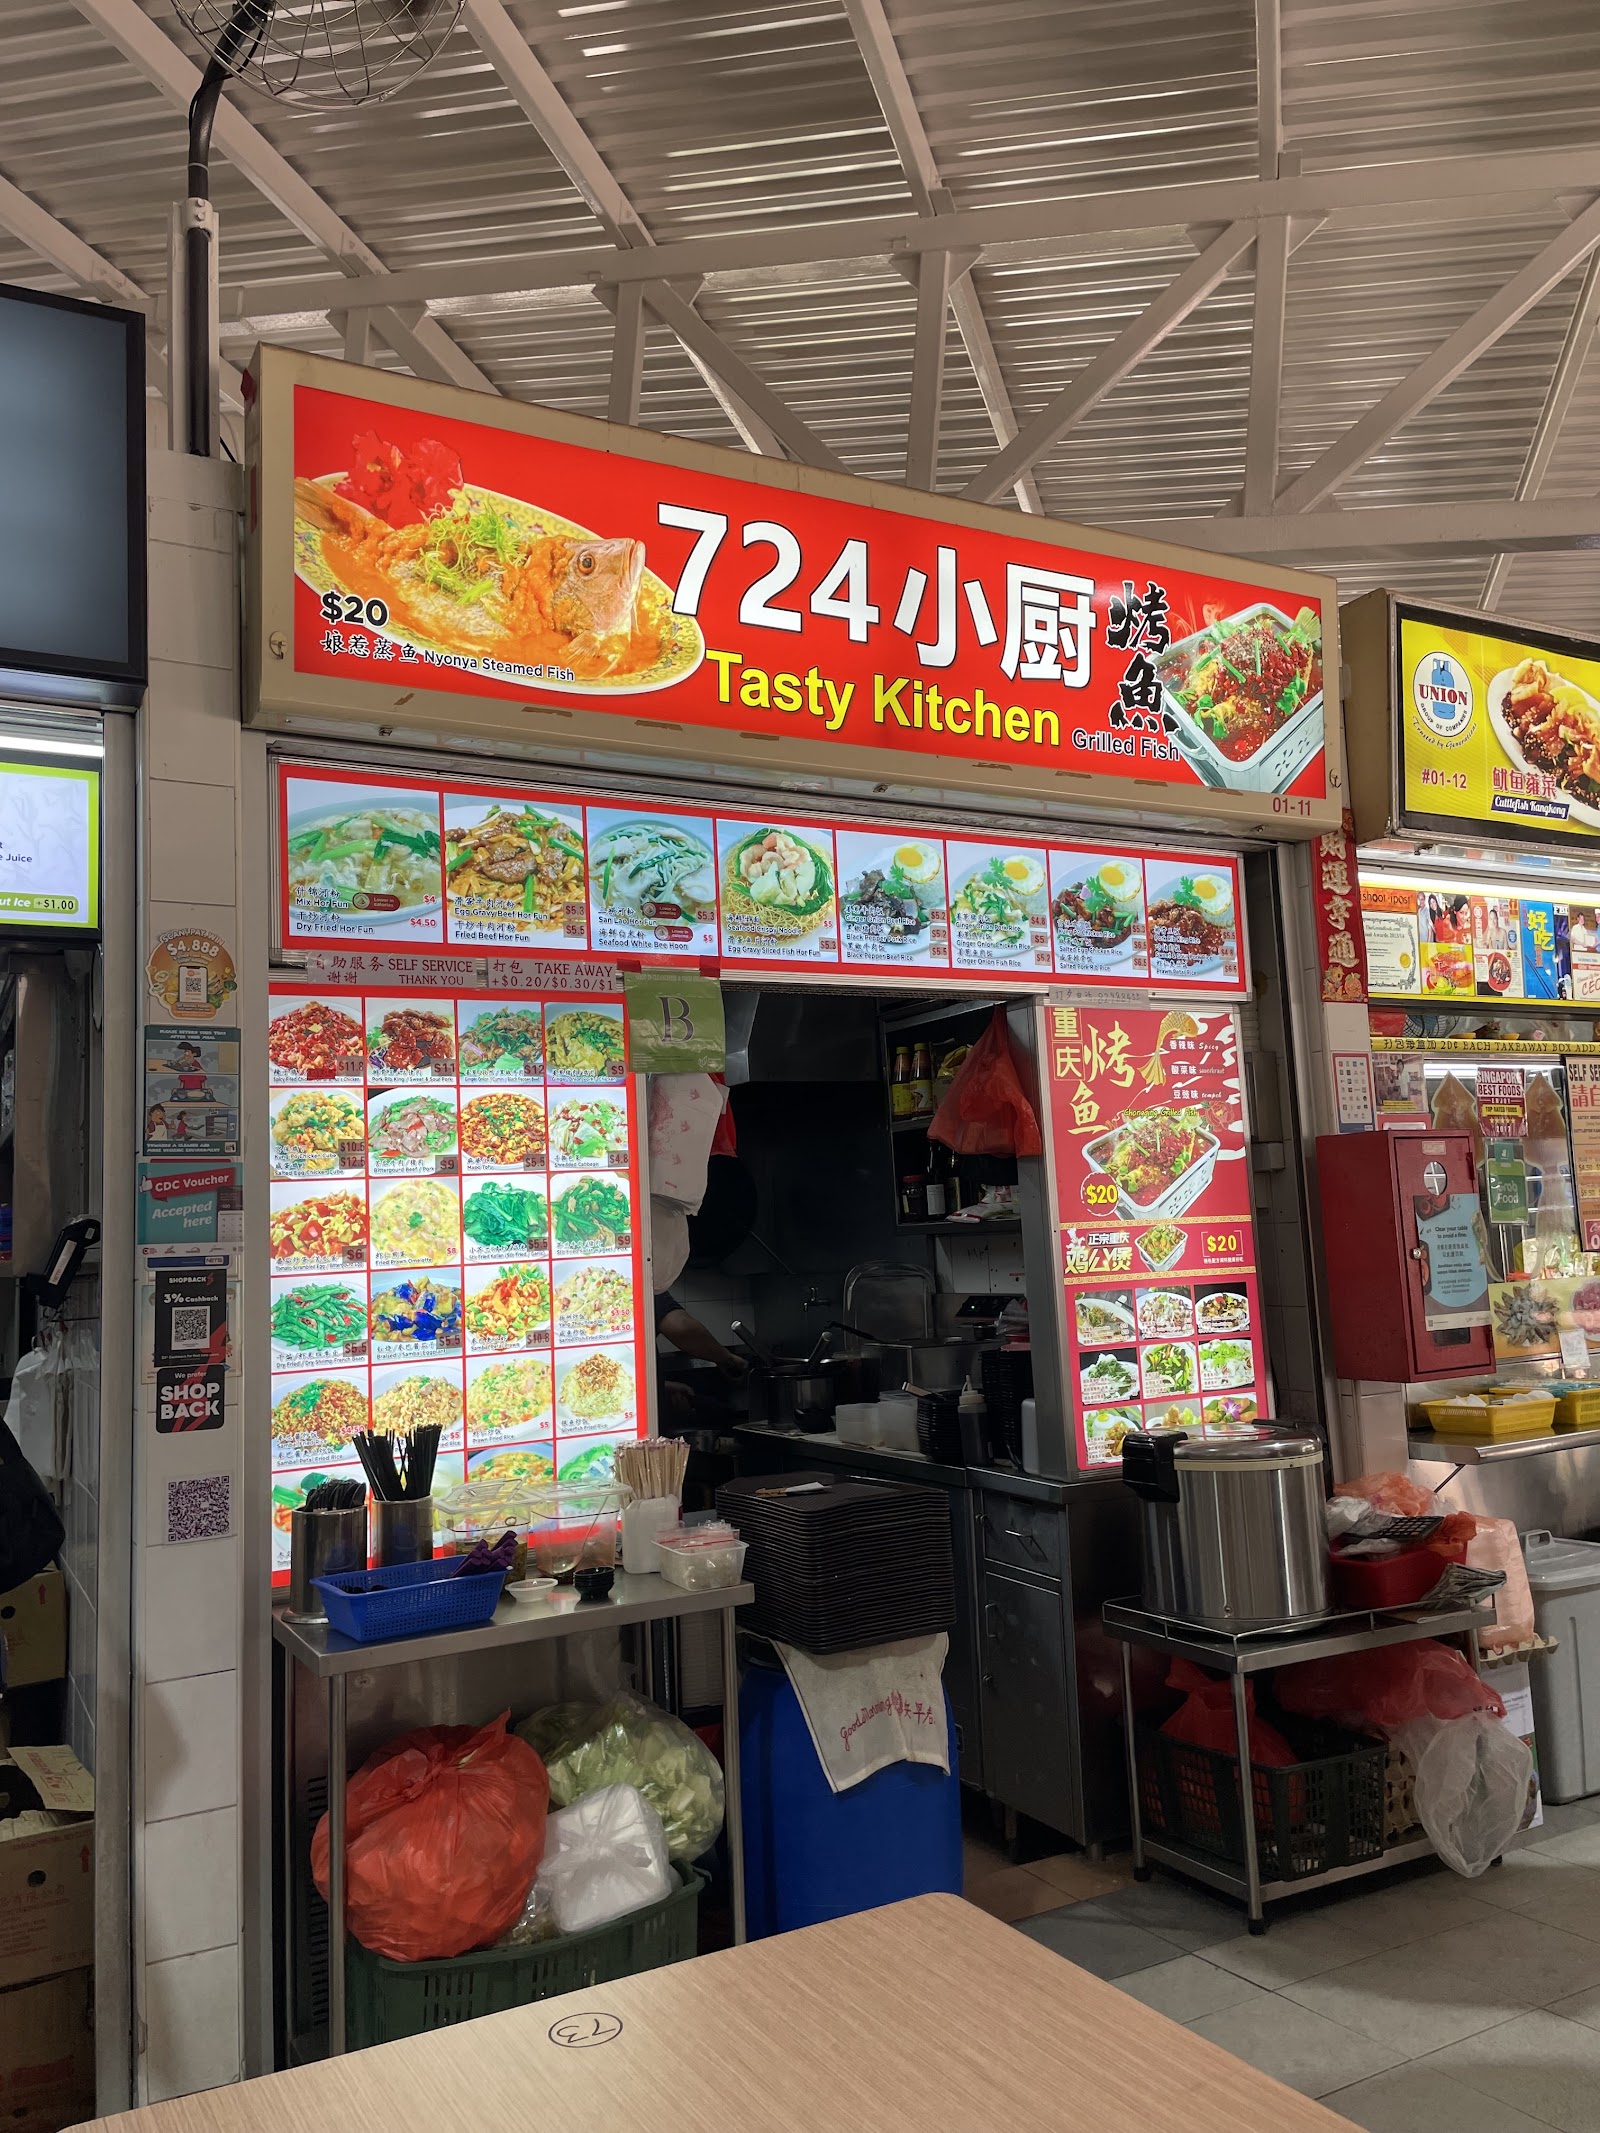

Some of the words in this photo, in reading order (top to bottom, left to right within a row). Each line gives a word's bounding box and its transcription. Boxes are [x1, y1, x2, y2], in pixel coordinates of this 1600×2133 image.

[320, 592, 389, 627] $20
[320, 631, 419, 664] 娘惹蒸鱼
[424, 650, 478, 672] Nyonya
[482, 657, 543, 681] Steamed
[546, 665, 575, 683] Fish
[706, 650, 856, 731] Tasty
[873, 673, 1060, 747] Kitchen
[1418, 683, 1468, 706] UNION
[1412, 716, 1437, 745] Trusted
[1437, 741, 1445, 749] by
[1446, 722, 1478, 749] Generations
[1072, 730, 1136, 757] Grilled
[1140, 736, 1180, 762] Fish
[1421, 768, 1468, 790] #01-12
[1272, 797, 1311, 817] 01-11
[1494, 796, 1530, 811] Cuttlefish
[1531, 800, 1567, 818] Kangkong
[6, 853, 33, 863] Juice
[14, 897, 31, 907] Ice
[296, 898, 311, 907] Mix
[314, 899, 330, 908] Hor
[332, 901, 349, 909] Fun
[423, 895, 436, 905] $4
[454, 907, 472, 917] Egg
[472, 909, 497, 919] Gravy
[497, 910, 516, 919] Beef
[517, 911, 532, 919] Hor
[533, 912, 549, 920] Fun
[565, 905, 585, 915] $5.3
[697, 910, 715, 921] $5.3
[931, 911, 946, 920] $5.2
[410, 917, 437, 928] $4.50
[823, 920, 834, 929] $5
[1031, 916, 1046, 926] $4.8
[296, 922, 312, 932] Dry
[314, 923, 337, 932] Fried
[340, 924, 356, 933] Hor
[358, 926, 374, 934] Fun
[566, 925, 586, 935] $5.5
[931, 929, 947, 938] $5.2
[1132, 925, 1146, 933] $5.3
[1527, 909, 1554, 951] 好吃
[208, 931, 226, 947] WIN
[455, 930, 477, 939] Fried
[478, 931, 498, 940] Beef
[498, 932, 514, 941] Hor
[515, 933, 531, 942] Fun
[1034, 935, 1046, 944] $5
[1222, 931, 1236, 940] $5.5
[166, 938, 220, 957] $4,888
[598, 938, 629, 947] Seafood
[631, 940, 653, 948] White
[653, 941, 669, 949] Bee
[669, 942, 689, 950] Hoon
[820, 940, 837, 950] $5.3
[728, 945, 741, 954] Egg
[742, 946, 761, 956] Gravy
[761, 947, 781, 955] Sliced
[781, 948, 795, 956] Fish
[795, 949, 808, 957] Hor
[808, 949, 821, 957] Fun
[932, 947, 948, 956] $5.5
[314, 953, 384, 972] 自助服务
[1036, 953, 1051, 962] $5.2
[388, 958, 419, 971] SELF
[421, 960, 473, 973] SERVICE
[492, 959, 523, 974] 打包
[534, 962, 571, 975] TAKE
[574, 964, 614, 978] AWAY
[327, 971, 358, 984] 谢谢
[398, 974, 437, 985] THANK
[440, 975, 464, 986] YOU
[491, 974, 614, 991] +$0.20/$0.30/$1
[656, 995, 695, 1044] B
[1053, 1006, 1082, 1078] 重庆
[1170, 1039, 1196, 1051] 香辣味
[1440, 1039, 1459, 1051] 20¢
[1463, 1040, 1491, 1051] EACH
[1495, 1041, 1548, 1052] TAKEAWAY
[1552, 1042, 1572, 1053] BOX
[1575, 1043, 1596, 1053] ADD
[338, 1061, 364, 1073] $11.8
[434, 1064, 456, 1074] $11
[524, 1065, 545, 1075] $12
[611, 1065, 625, 1075] $9
[1171, 1064, 1197, 1075] 酸菜味
[1569, 1062, 1587, 1081] SELF
[1067, 1020, 1137, 1136] 烤鱼
[1478, 1084, 1498, 1097] BEST
[1498, 1084, 1522, 1097] FOODS
[1496, 1125, 1512, 1134] 2017
[340, 1156, 365, 1168] $12.5
[440, 1159, 455, 1170] $9
[525, 1157, 546, 1168] $5.5
[609, 1154, 630, 1165] $4.8
[155, 1180, 180, 1192] CDC
[183, 1174, 230, 1188] Voucher
[1086, 1184, 1118, 1205] $20
[1494, 1193, 1520, 1206] Food
[152, 1200, 213, 1220] Accepted
[183, 1215, 213, 1228] here
[527, 1238, 549, 1250] $5.5
[617, 1235, 632, 1246] $9
[1088, 1231, 1131, 1246] 正宗重庆
[1206, 1234, 1238, 1253] $20
[346, 1249, 363, 1261] $6
[1064, 1246, 1133, 1275] 鸡公煲
[168, 1276, 207, 1285] SHOPBACK
[163, 1293, 185, 1304] 3%
[185, 1295, 219, 1303] Cashback
[610, 1308, 631, 1317] $3.50
[610, 1324, 632, 1333] $4.50
[439, 1335, 461, 1347] $5.5
[526, 1332, 550, 1345] $10.8
[345, 1342, 368, 1354] $5.5
[174, 1371, 186, 1379] We
[187, 1371, 207, 1381] prefer
[160, 1382, 220, 1402] SHOP
[160, 1400, 220, 1420] BACK
[624, 1411, 634, 1420] $5
[340, 1425, 366, 1436] $4.50
[539, 1421, 550, 1430] $5
